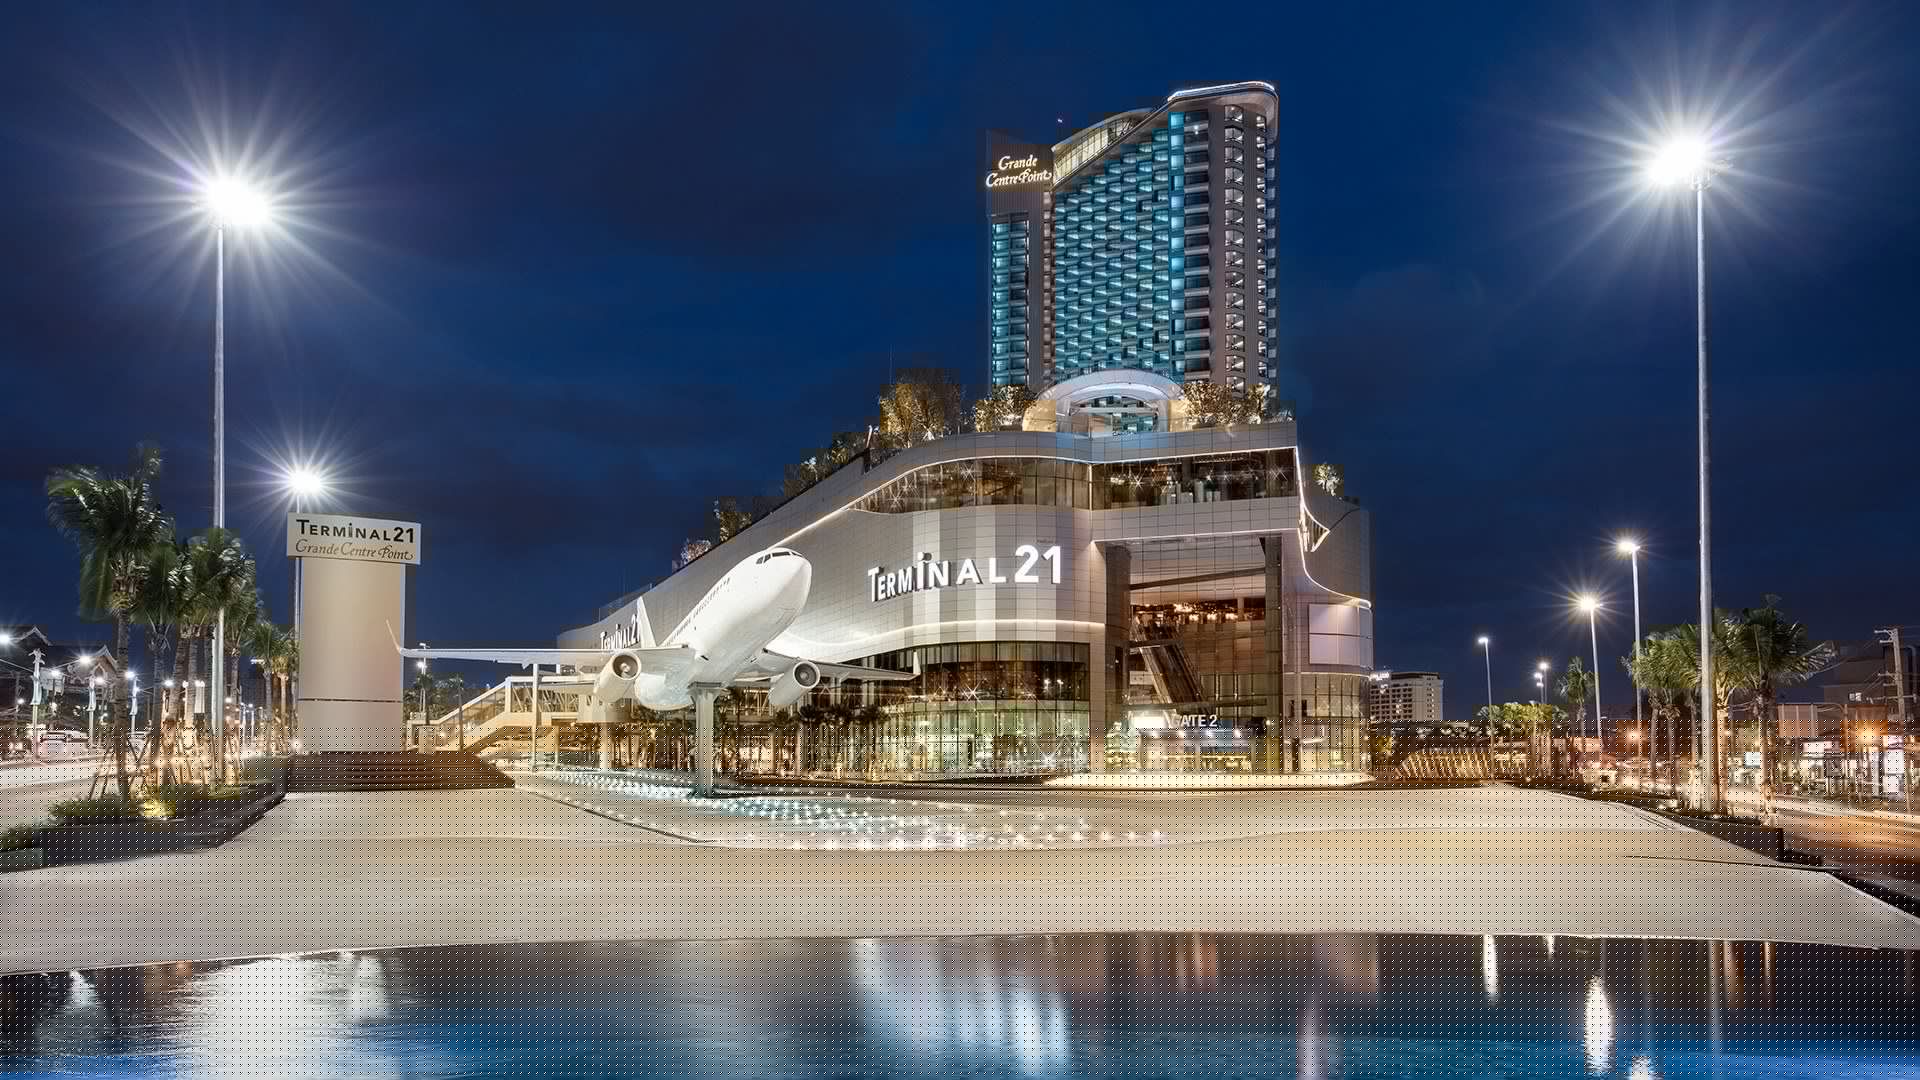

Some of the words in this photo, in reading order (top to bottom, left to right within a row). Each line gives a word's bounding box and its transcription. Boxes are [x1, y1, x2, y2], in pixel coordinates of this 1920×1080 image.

[998, 154, 1038, 171] Grande
[295, 538, 339, 555] Grande
[340, 541, 378, 558] Centre
[1208, 714, 1218, 727] 2
